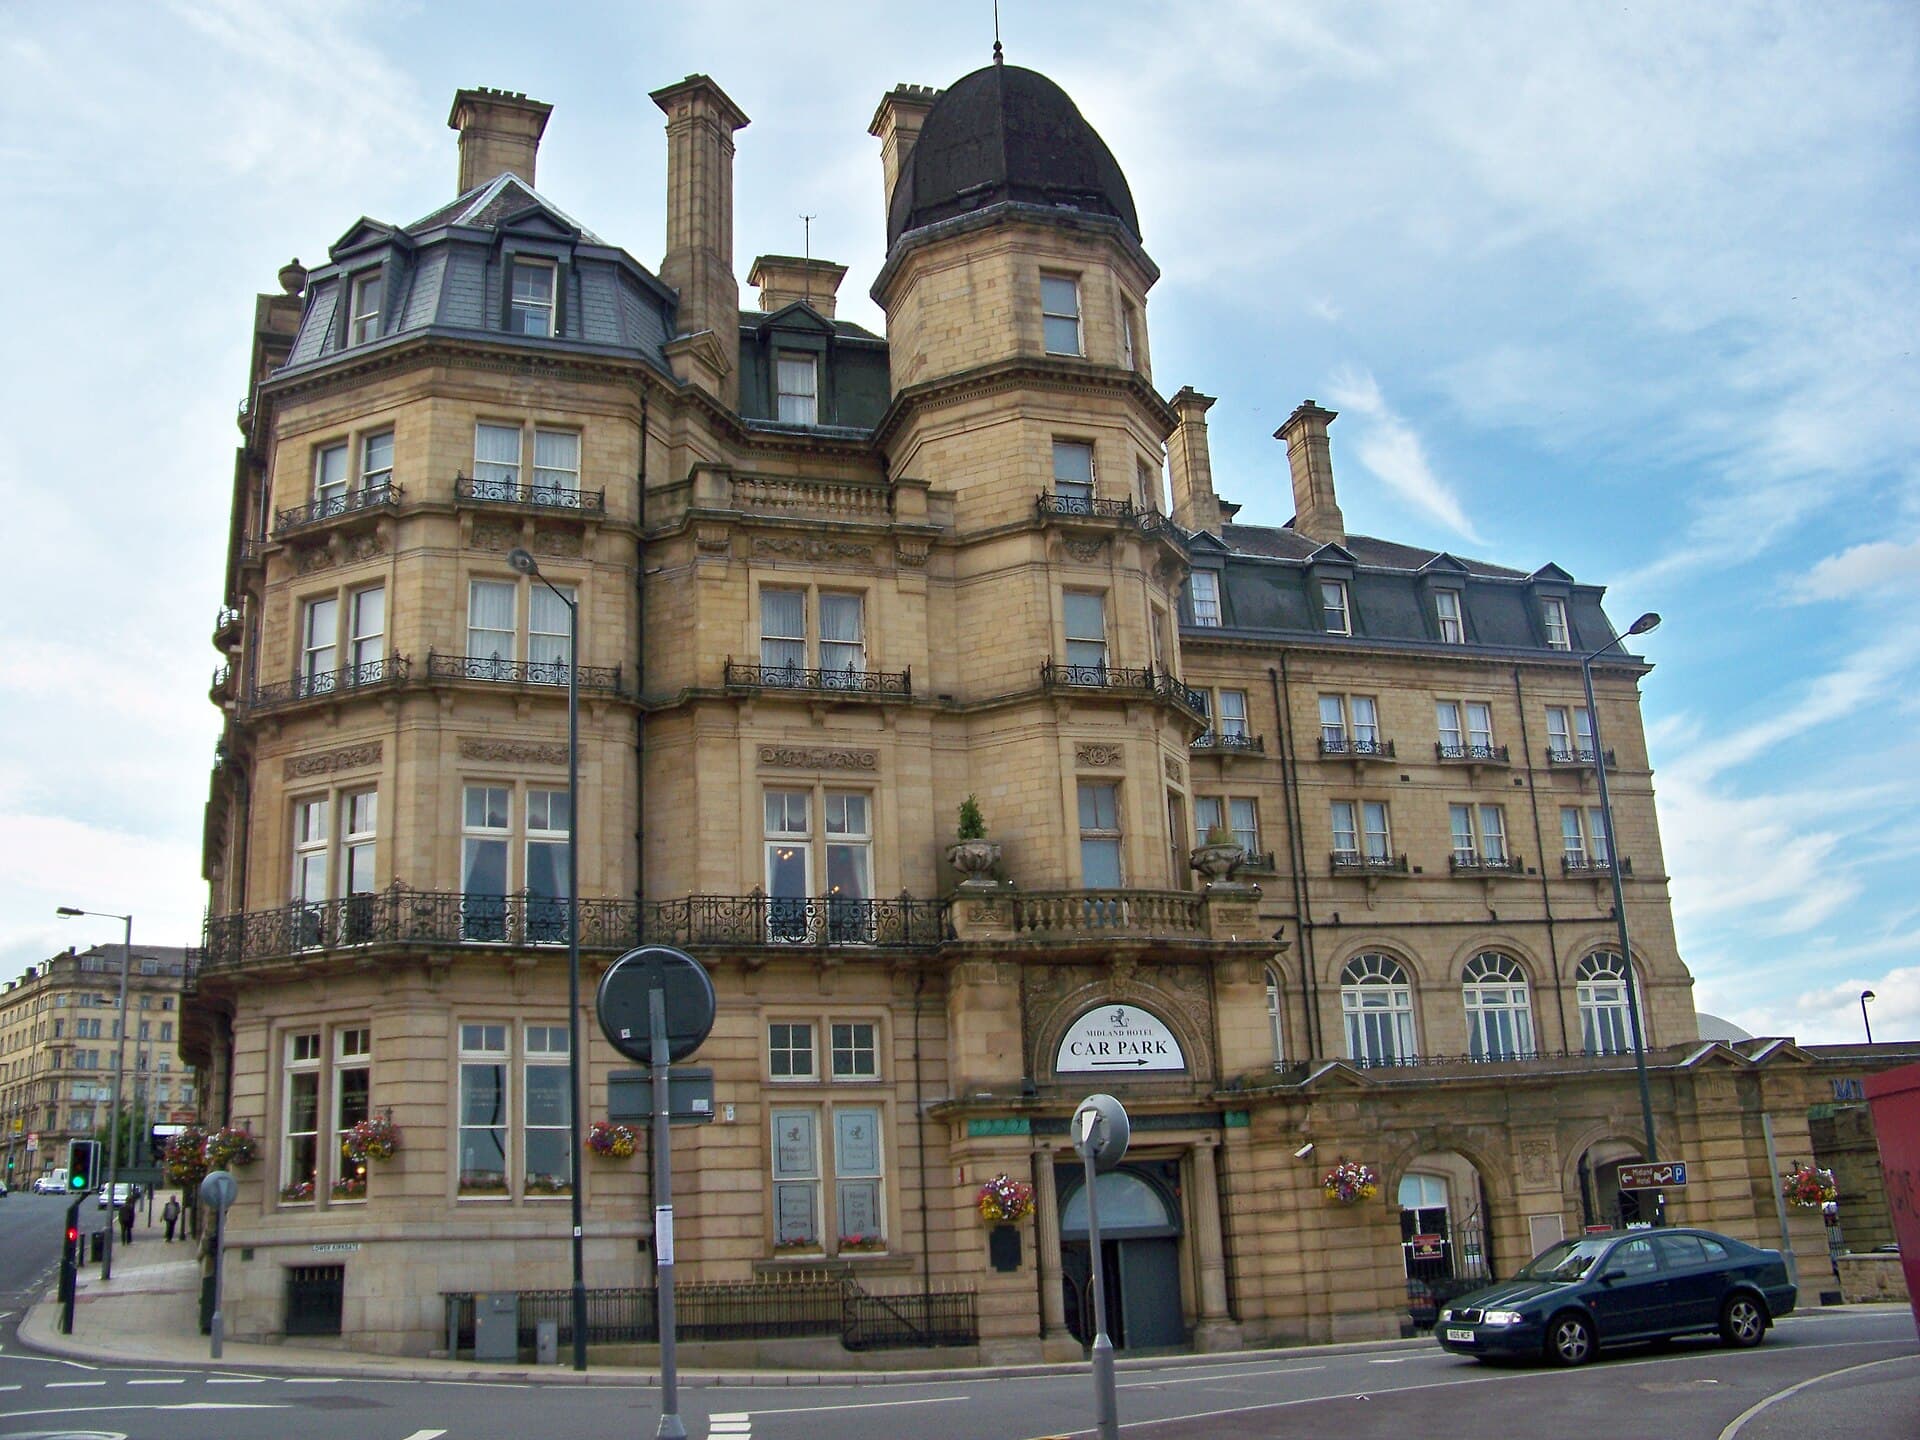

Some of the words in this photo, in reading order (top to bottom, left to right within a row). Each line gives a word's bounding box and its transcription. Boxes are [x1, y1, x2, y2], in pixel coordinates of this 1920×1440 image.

[1086, 1029, 1125, 1037] MIDLAND
[1070, 1041, 1111, 1056] CAR
[1118, 1040, 1168, 1055] PARK
[1676, 1168, 1682, 1180] P
